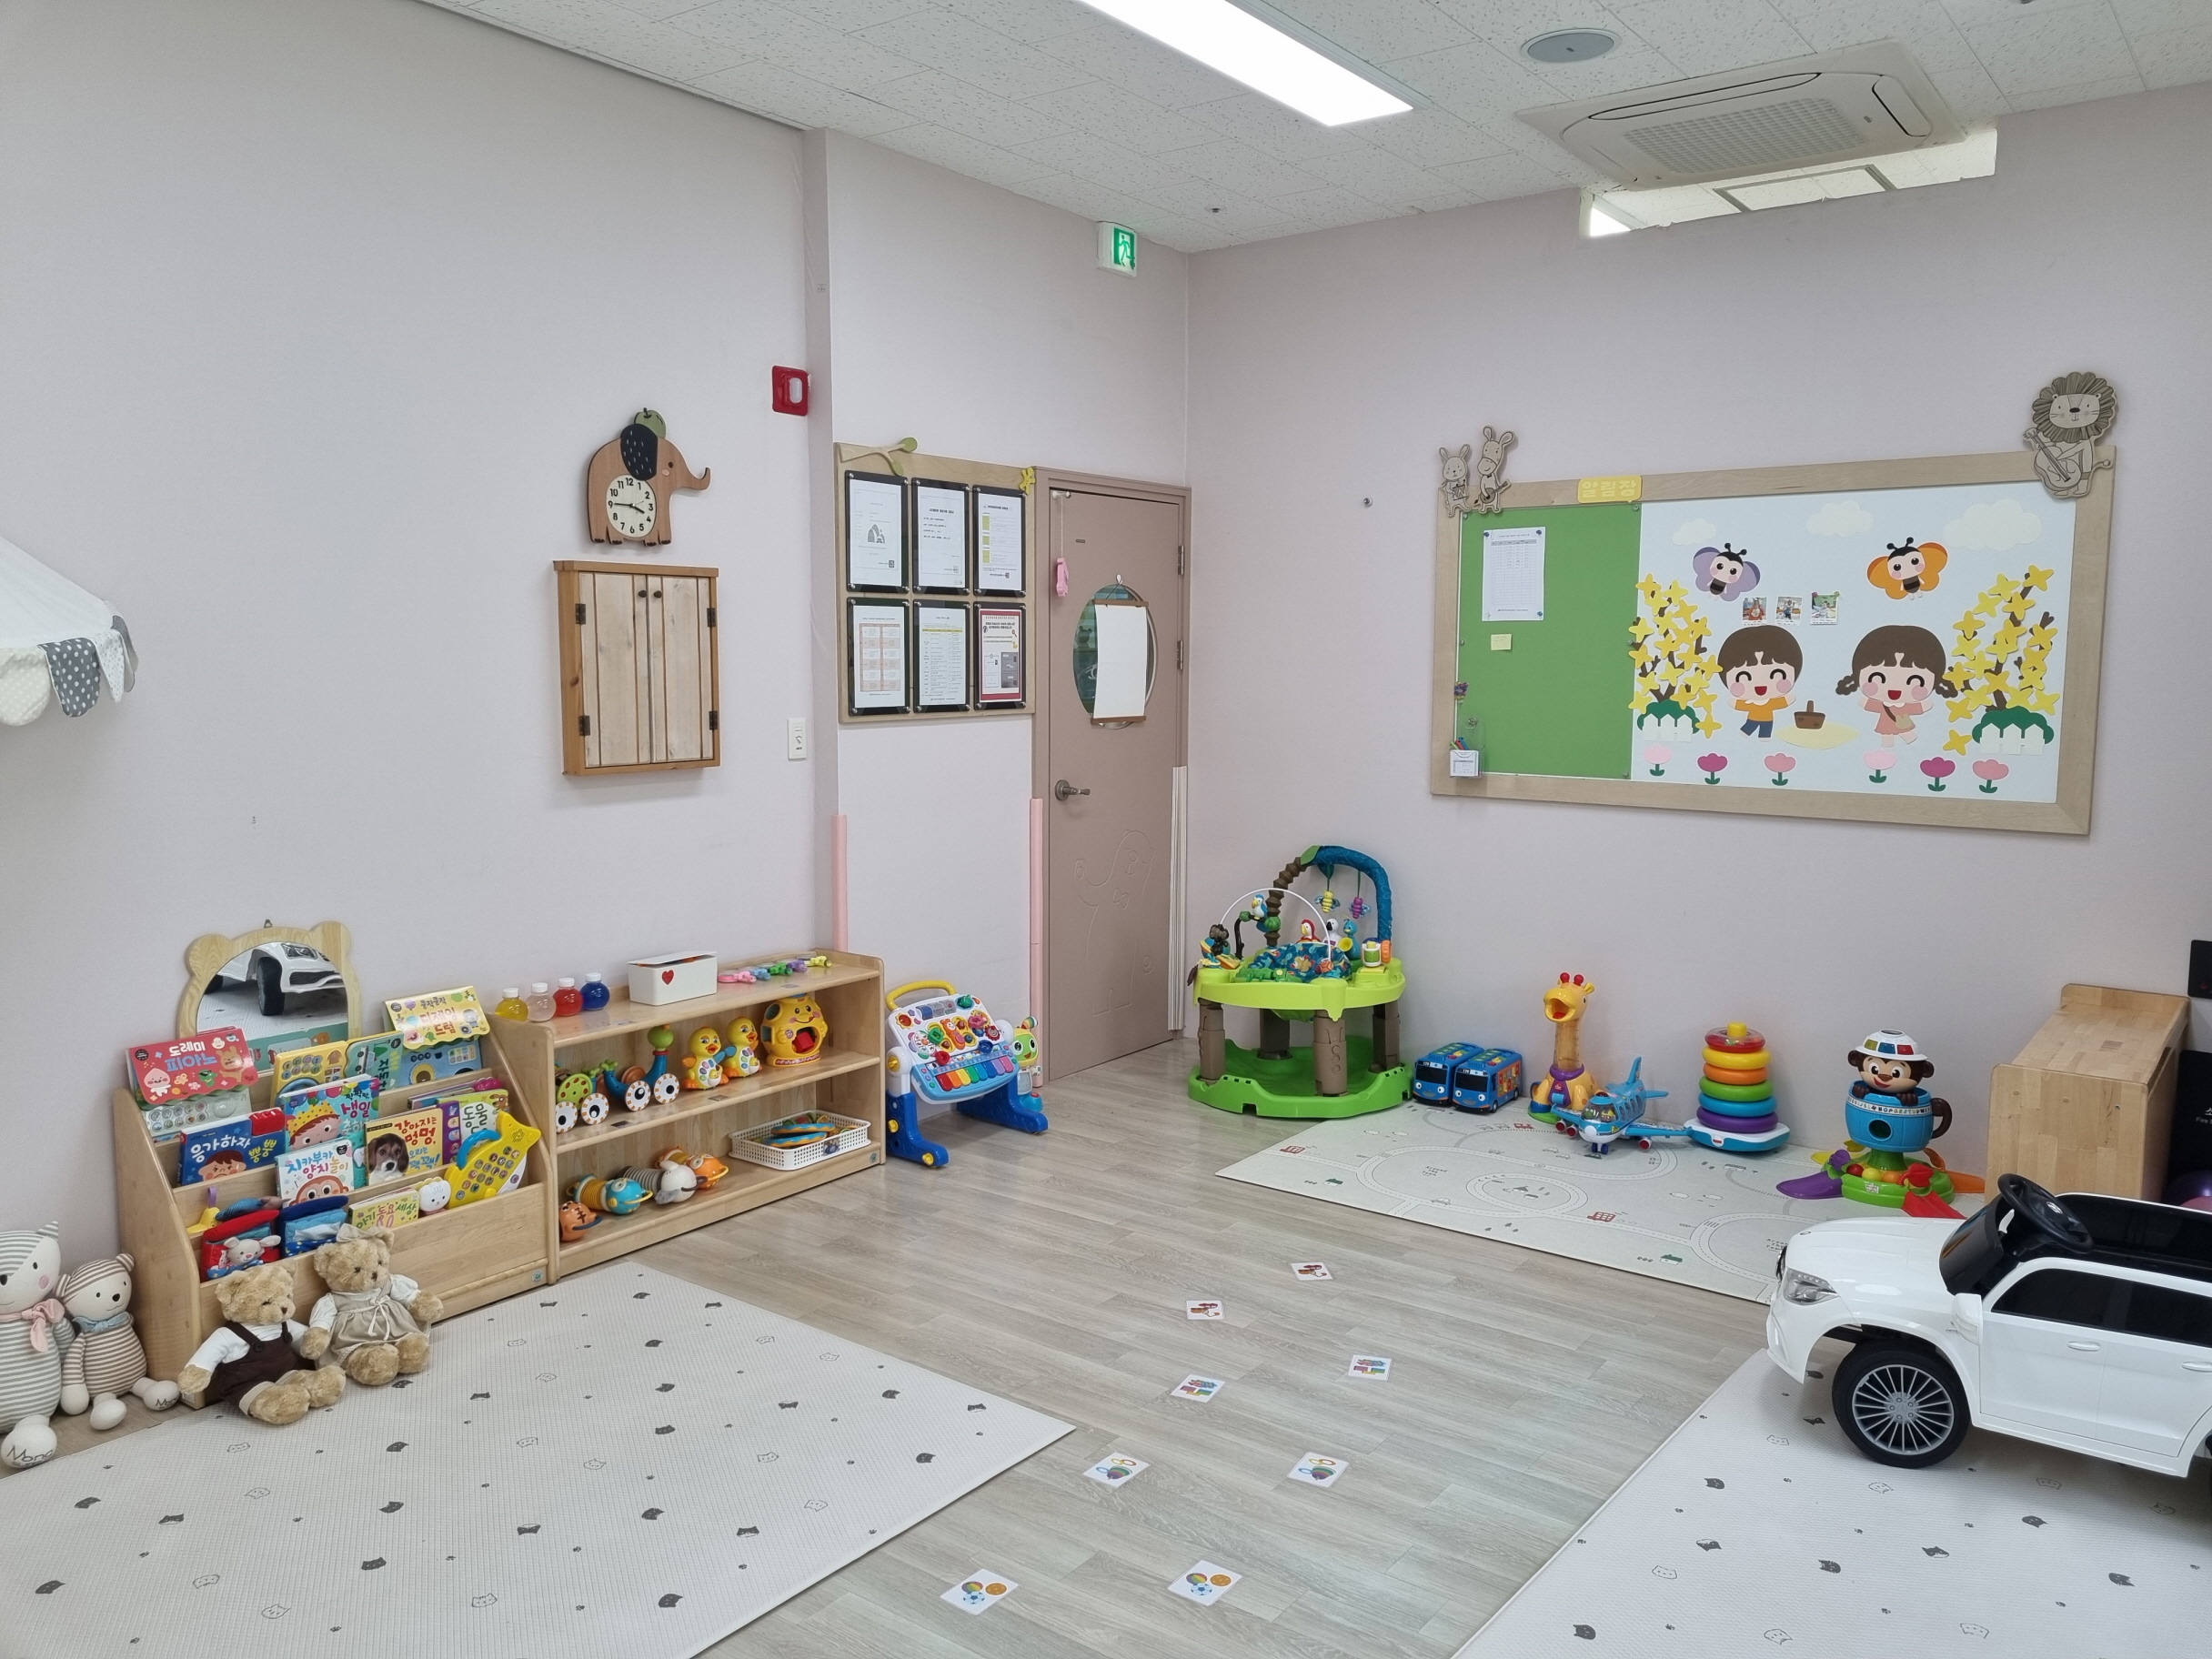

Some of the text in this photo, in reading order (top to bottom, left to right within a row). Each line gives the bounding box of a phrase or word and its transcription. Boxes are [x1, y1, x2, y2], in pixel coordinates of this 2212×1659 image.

[618, 480, 624, 489] 11
[626, 478, 634, 486] 12
[610, 488, 618, 497] 10
[645, 491, 649, 499] 2
[1582, 480, 1636, 498] 알림장
[608, 500, 613, 508] 9
[649, 503, 653, 511] 3
[613, 512, 618, 520] 8
[620, 522, 625, 530] 7
[630, 526, 635, 534] 6
[639, 523, 644, 531] 5
[434, 1021, 457, 1036] 드럼
[169, 1041, 206, 1057] 도레미
[165, 1052, 217, 1072] 피아노
[340, 1099, 371, 1119] 생일
[462, 1102, 488, 1129] 동물
[394, 1116, 437, 1134] 강아지는
[190, 1133, 251, 1163] 응가하자
[248, 1139, 277, 1163] 뿡뿡
[409, 1147, 428, 1159] 오리는
[284, 1151, 333, 1174] 치카부카
[356, 1202, 417, 1229] 아기 동요 세상
